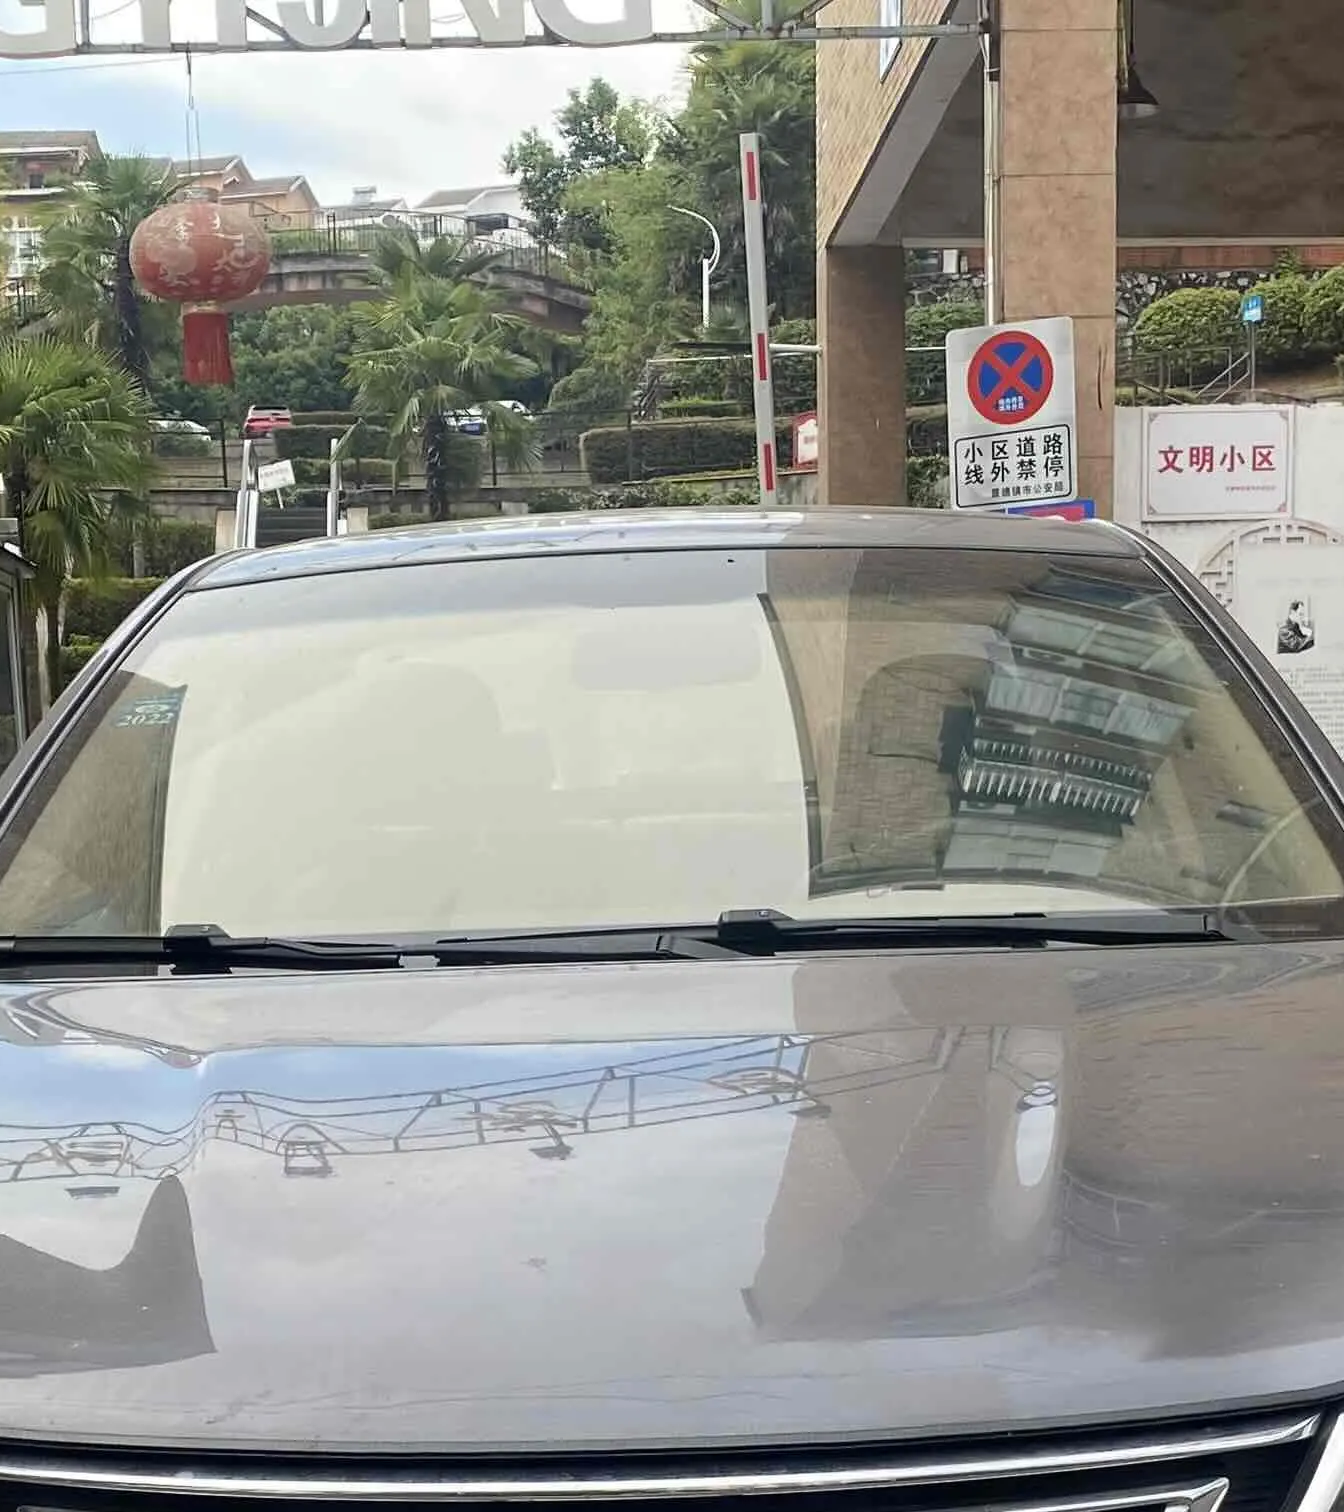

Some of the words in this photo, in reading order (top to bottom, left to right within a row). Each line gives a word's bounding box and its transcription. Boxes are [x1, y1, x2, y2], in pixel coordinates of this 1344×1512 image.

[964, 433, 1063, 463] 小区道路
[1158, 445, 1276, 473] 文明小区
[964, 455, 1064, 486] 线外禁停
[115, 712, 175, 728] 2022
